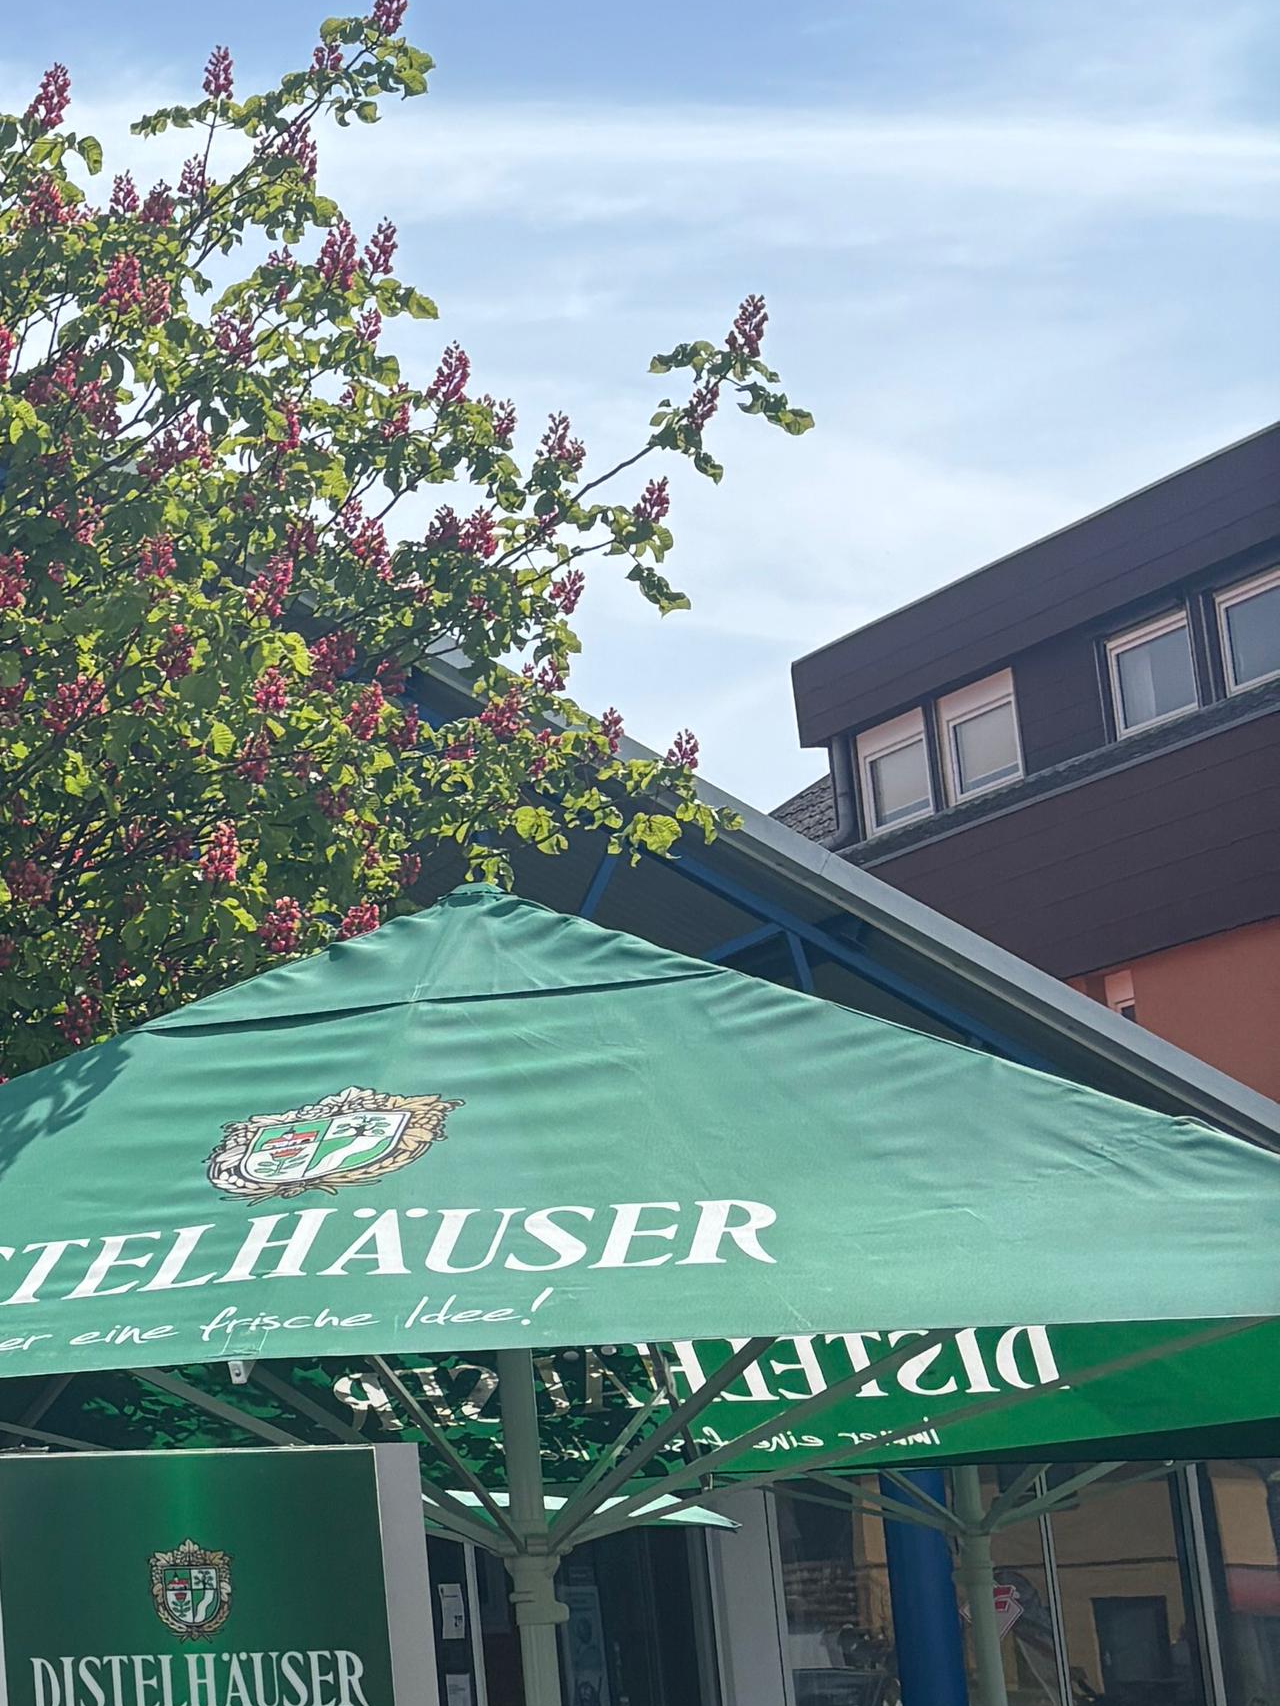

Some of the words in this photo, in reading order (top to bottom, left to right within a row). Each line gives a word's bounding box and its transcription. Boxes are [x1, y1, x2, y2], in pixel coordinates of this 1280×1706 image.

[69, 1324, 180, 1345] eine
[199, 1306, 380, 1342] frische
[403, 1286, 554, 1329] Idee!
